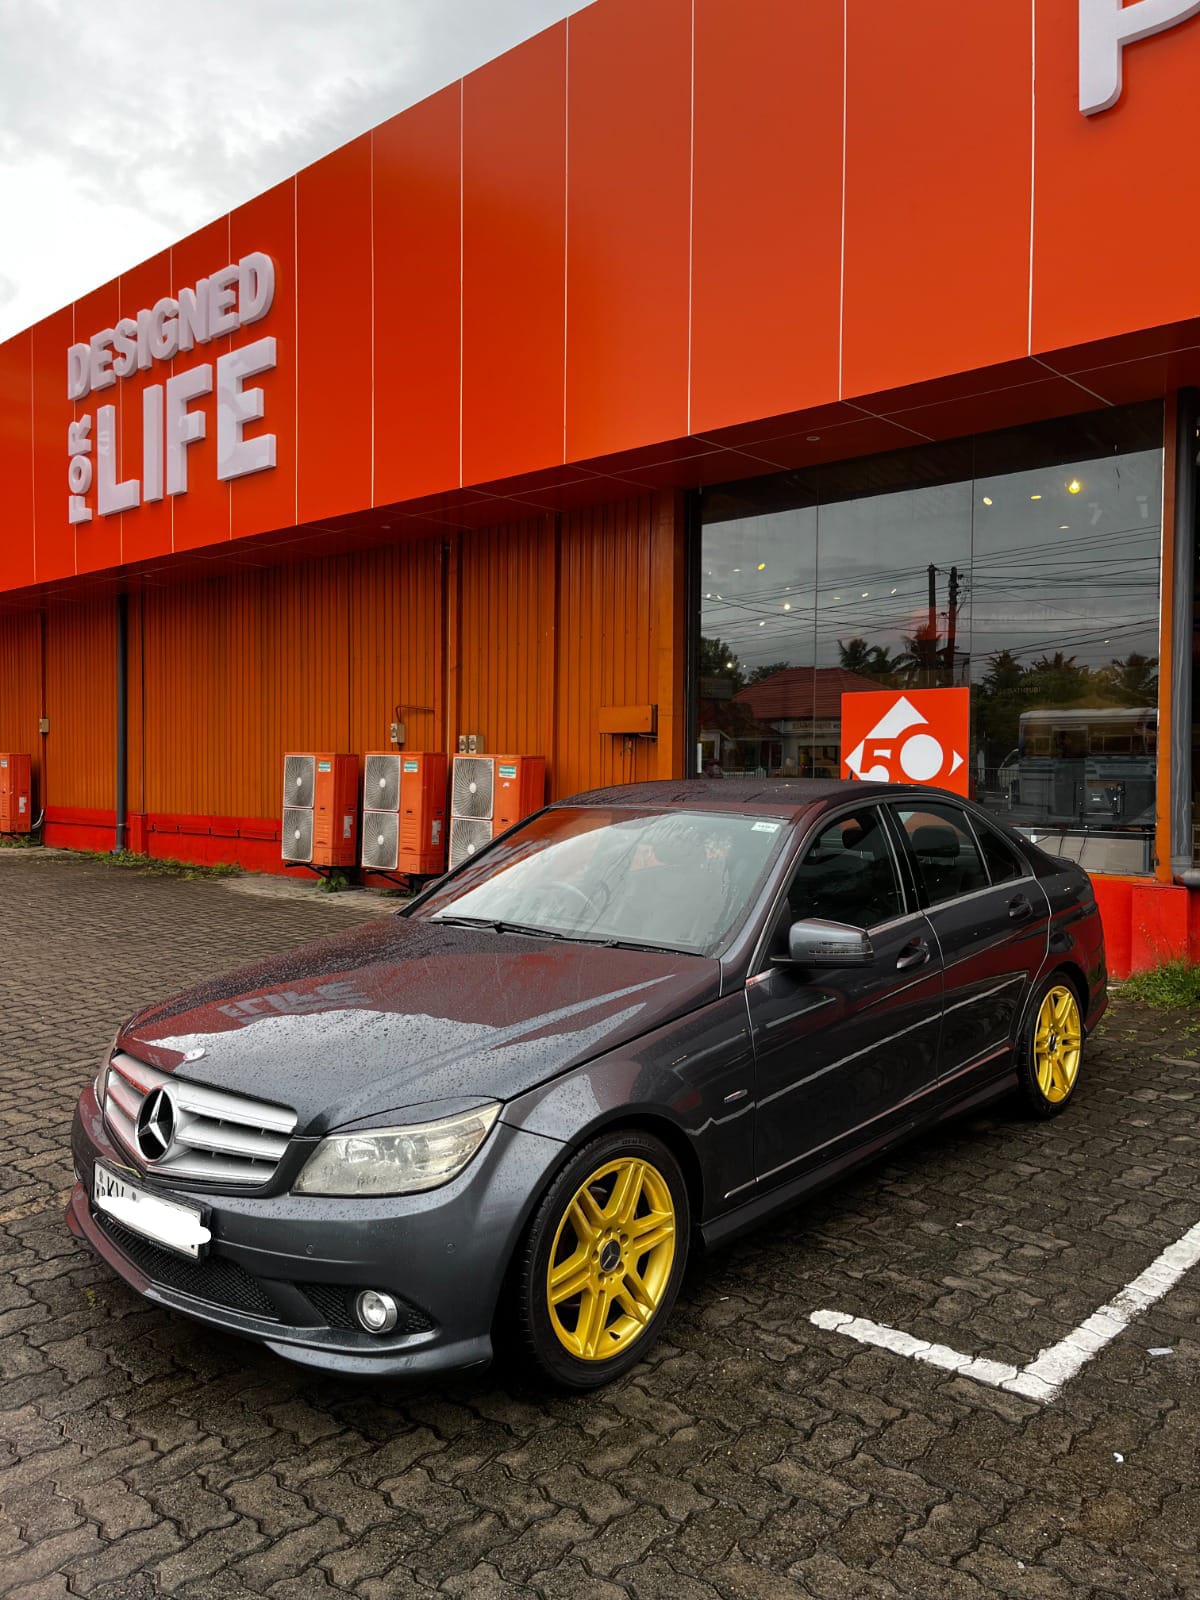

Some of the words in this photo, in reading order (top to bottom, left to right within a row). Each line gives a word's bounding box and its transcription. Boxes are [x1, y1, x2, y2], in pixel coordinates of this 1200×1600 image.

[67, 251, 275, 400] DESIGNED
[68, 414, 93, 524] FOR
[97, 336, 276, 516] LIFE
[859, 724, 954, 787] 50
